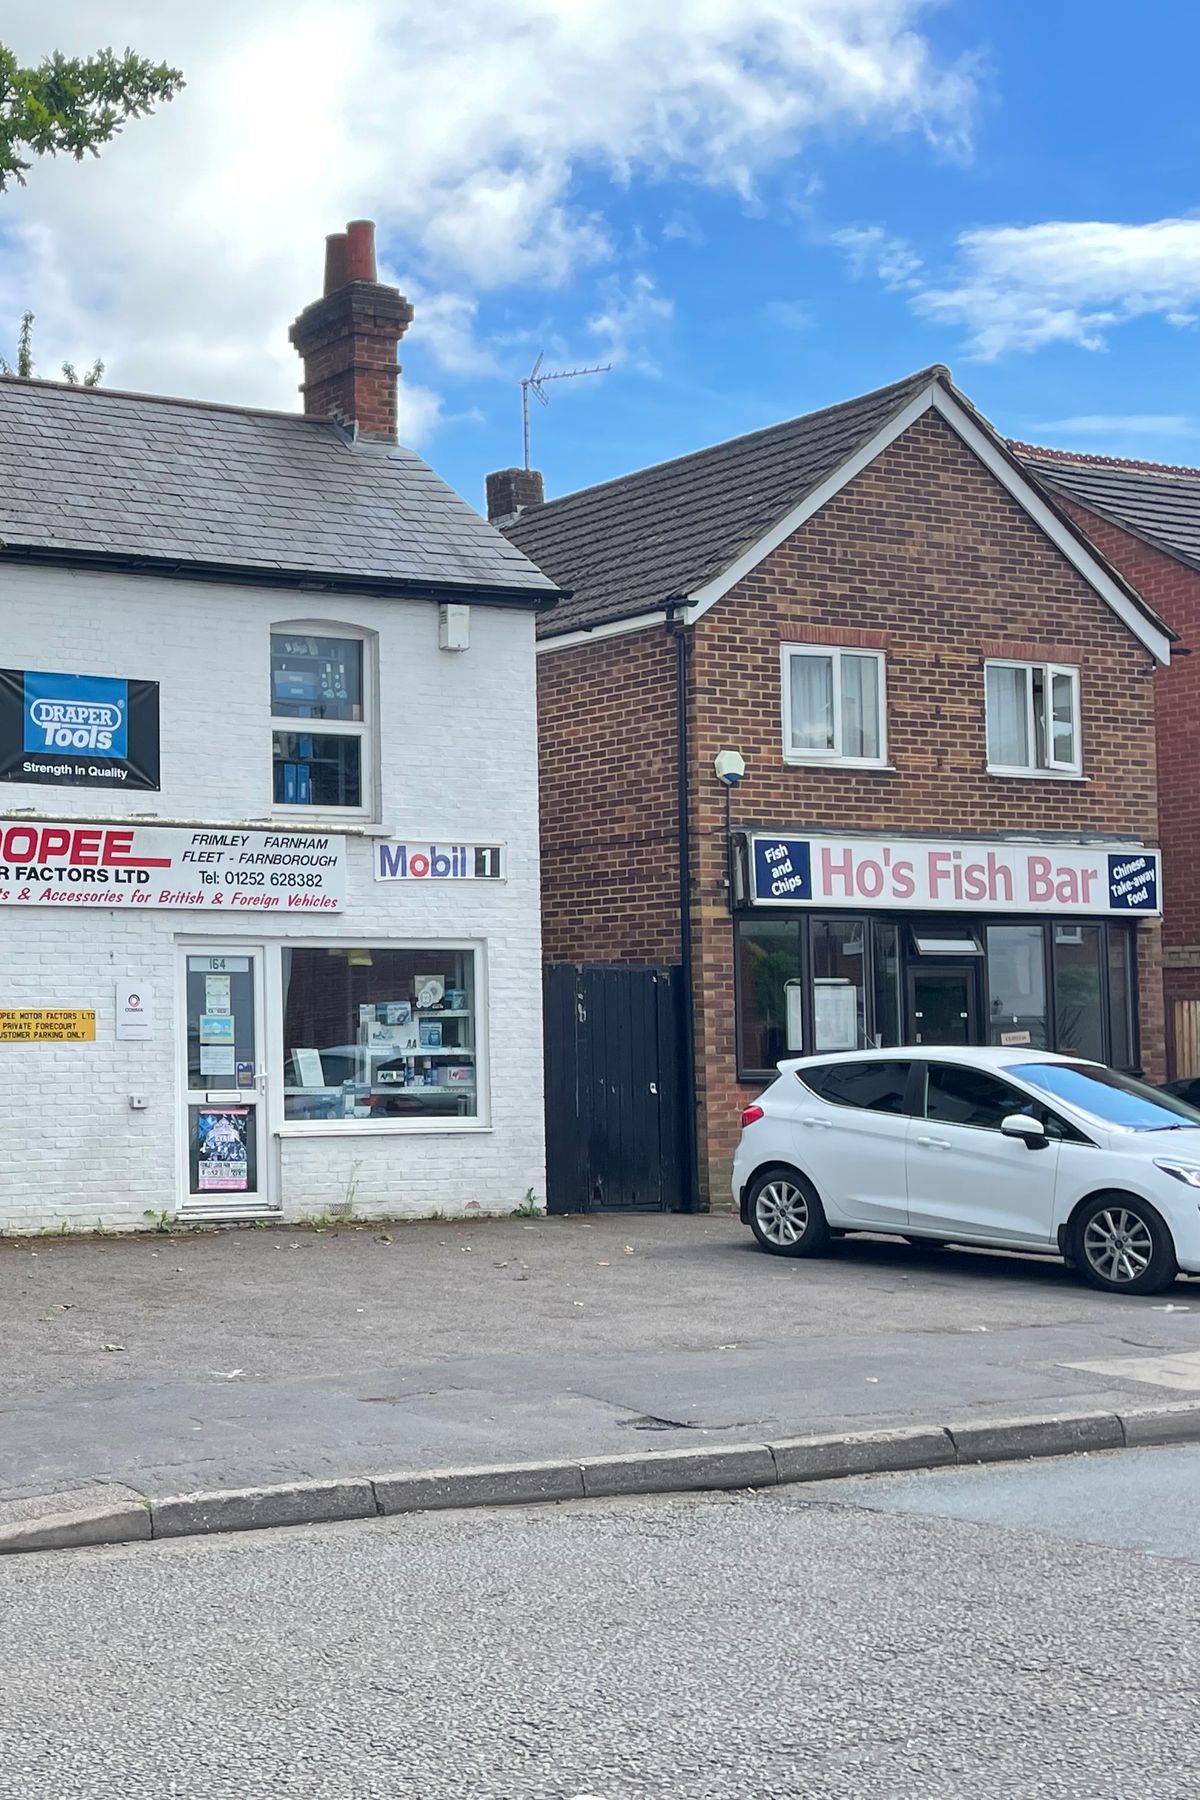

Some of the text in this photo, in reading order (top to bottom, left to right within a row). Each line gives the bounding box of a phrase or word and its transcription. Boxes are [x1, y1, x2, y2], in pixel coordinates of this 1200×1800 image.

[40, 704, 113, 725] DRAPER
[41, 721, 113, 749] Tools
[23, 762, 128, 780] Strength In Quality
[191, 834, 329, 850] FRIMLEY FARNHAM
[182, 851, 224, 864] FLEET
[238, 853, 338, 867] FARNBOROUGH
[380, 845, 492, 877] Mobil 1
[764, 844, 789, 863] Fish
[15, 866, 109, 883] FACTORS
[114, 869, 150, 884] LTD
[771, 858, 793, 879] and
[821, 847, 1098, 904] Ho's Fish Bar
[1112, 857, 1146, 880] Chinese
[199, 870, 323, 888] Tel: 01252 628382
[771, 875, 802, 896] Chips
[1110, 868, 1155, 898] Take-away
[17, 888, 31, 900] &
[39, 888, 123, 903] Accessories
[131, 889, 151, 904] for
[158, 890, 204, 905] British
[211, 892, 224, 905] &
[231, 892, 280, 908] Foreign
[288, 894, 338, 908] Vehicles
[1126, 886, 1149, 907] Food
[209, 959, 226, 970] 164
[20, 1012, 43, 1020] MOTOR
[46, 1012, 77, 1020] FACTORS
[34, 1031, 63, 1039] PARKING
[66, 1031, 86, 1039] ONLY
